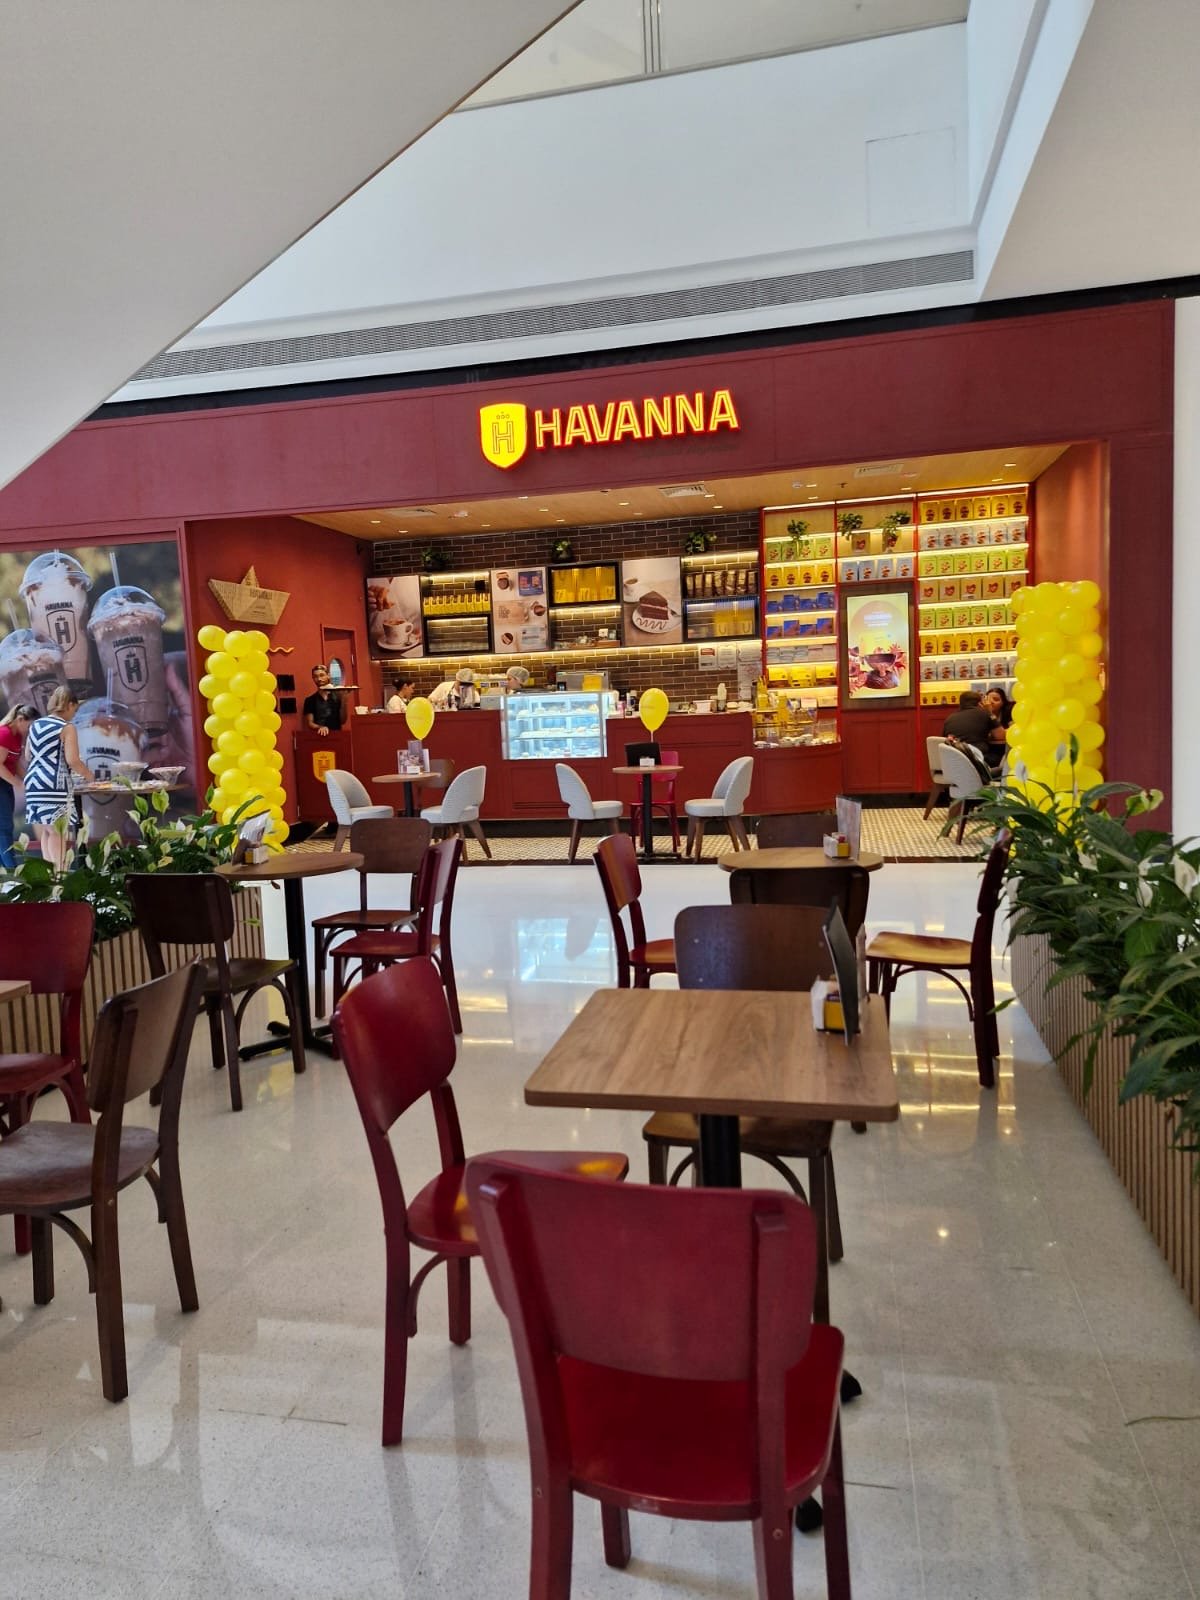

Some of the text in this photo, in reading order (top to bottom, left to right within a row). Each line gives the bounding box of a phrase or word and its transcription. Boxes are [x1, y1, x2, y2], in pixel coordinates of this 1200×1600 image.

[534, 389, 739, 448] HAVANNA
[492, 421, 515, 454] H
[54, 621, 72, 645] H
[124, 658, 143, 684] H
